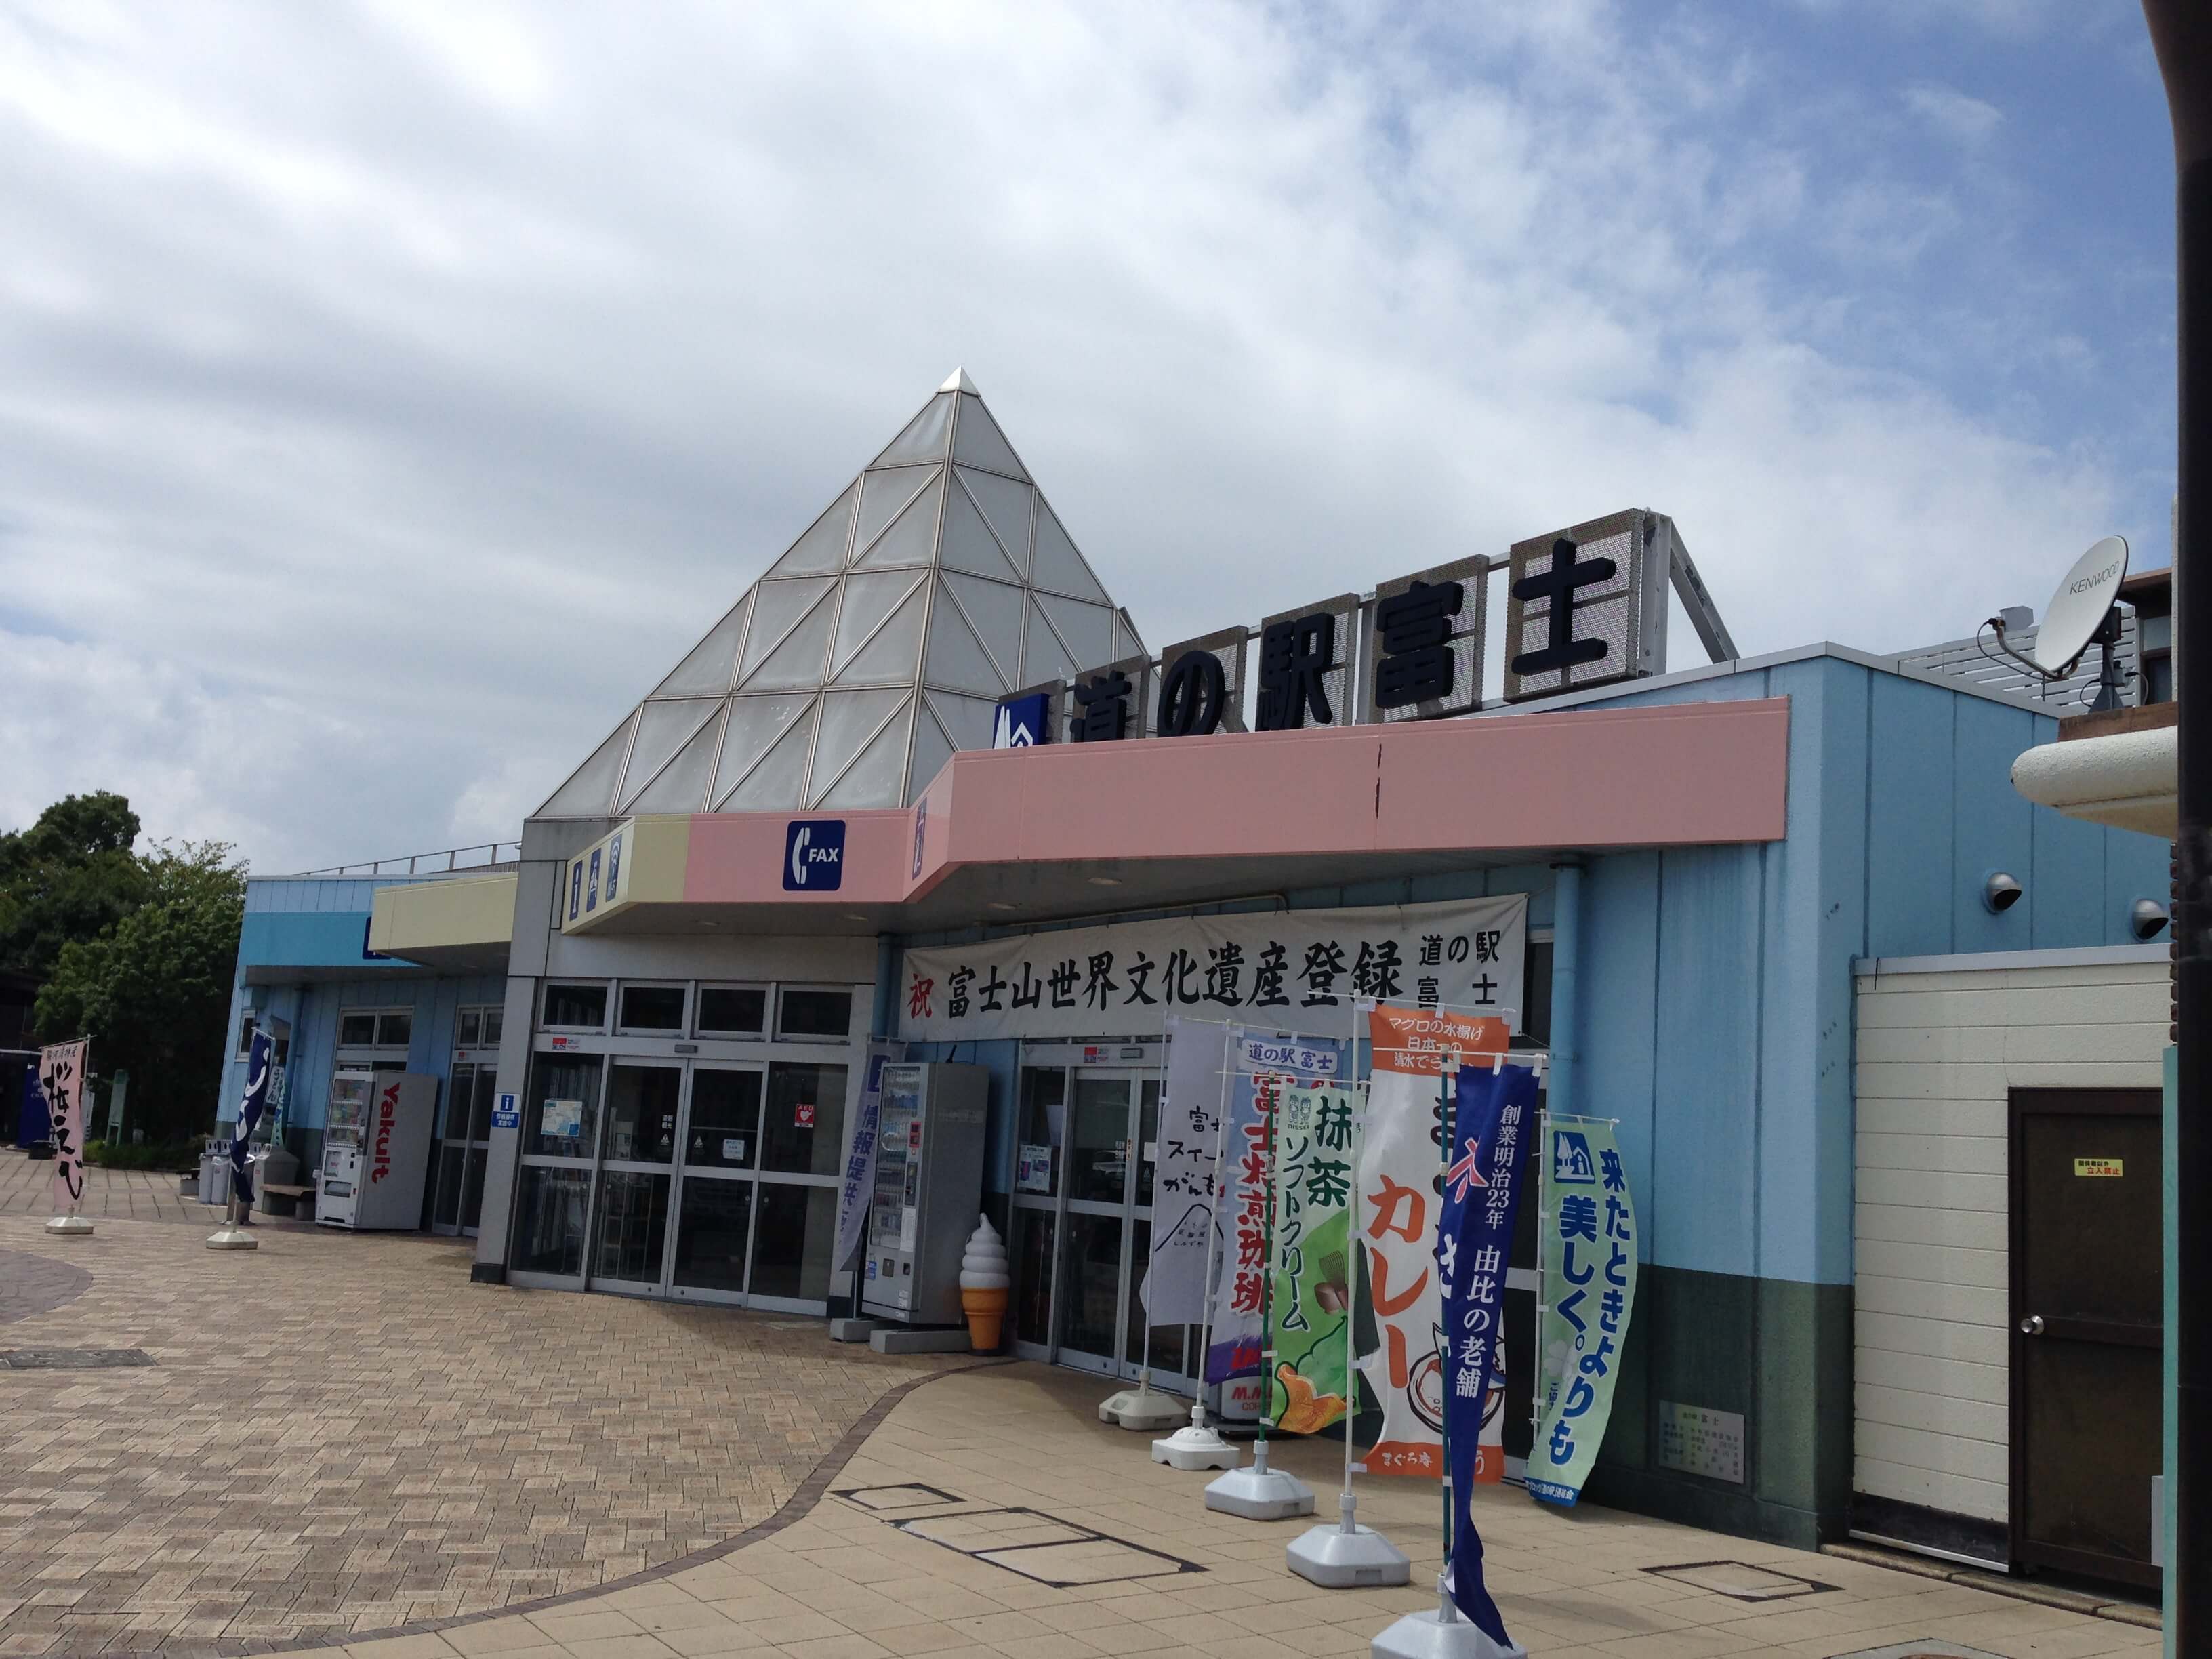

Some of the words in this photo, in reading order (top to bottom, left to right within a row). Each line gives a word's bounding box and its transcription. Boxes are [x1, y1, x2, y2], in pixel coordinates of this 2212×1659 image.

[2070, 560, 2119, 595] KENWOOD
[808, 848, 839, 863] FAX
[907, 972, 935, 1020] 祝
[947, 938, 1404, 1019] 富士山世界文化遺産登録
[1417, 973, 1498, 1009] 富士
[1419, 930, 1501, 967] 道の駅
[1248, 1043, 1296, 1064] 道の駅
[1300, 1051, 1333, 1070] 富士
[1389, 1017, 1486, 1040] マグロの水揚げ
[372, 1082, 401, 1184] Yakult
[1306, 1095, 1353, 1208] 抹茶
[1485, 1105, 1521, 1230] 創業明治23年
[2087, 1166, 2121, 1175] 立入禁止
[1279, 1136, 1309, 1331] ソフトクリーム
[1557, 1195, 1597, 1351] 美しく。
[1367, 1174, 1429, 1389] カレー
[1456, 1245, 1501, 1398] 由比の老舗
[1549, 1148, 1631, 1465] 来たときよりも
